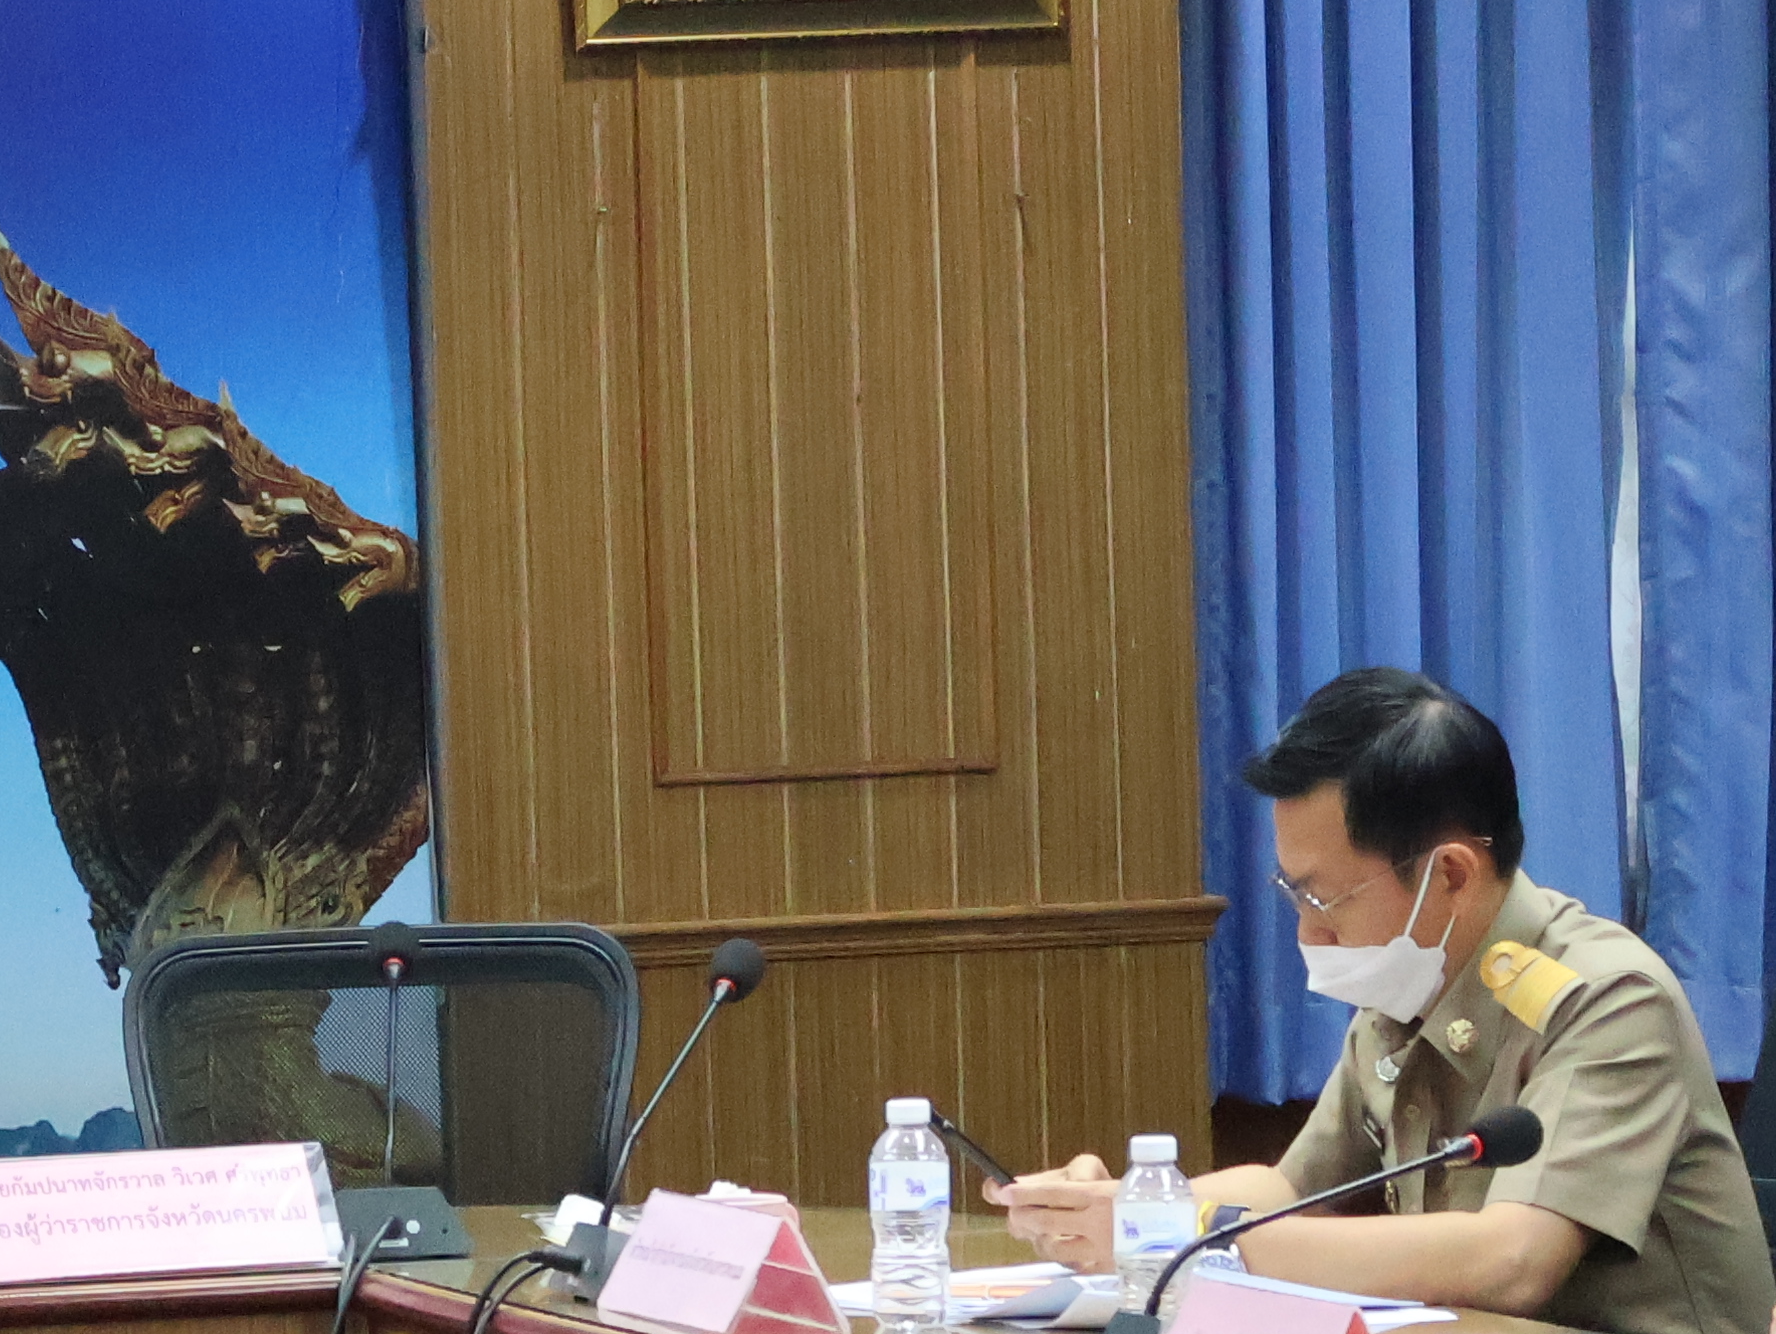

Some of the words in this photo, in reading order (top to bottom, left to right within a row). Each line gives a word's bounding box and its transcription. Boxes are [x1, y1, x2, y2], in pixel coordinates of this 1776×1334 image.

[173, 1166, 218, 1188] วิเวศ
[225, 1162, 302, 1188] ศรพุทธา
